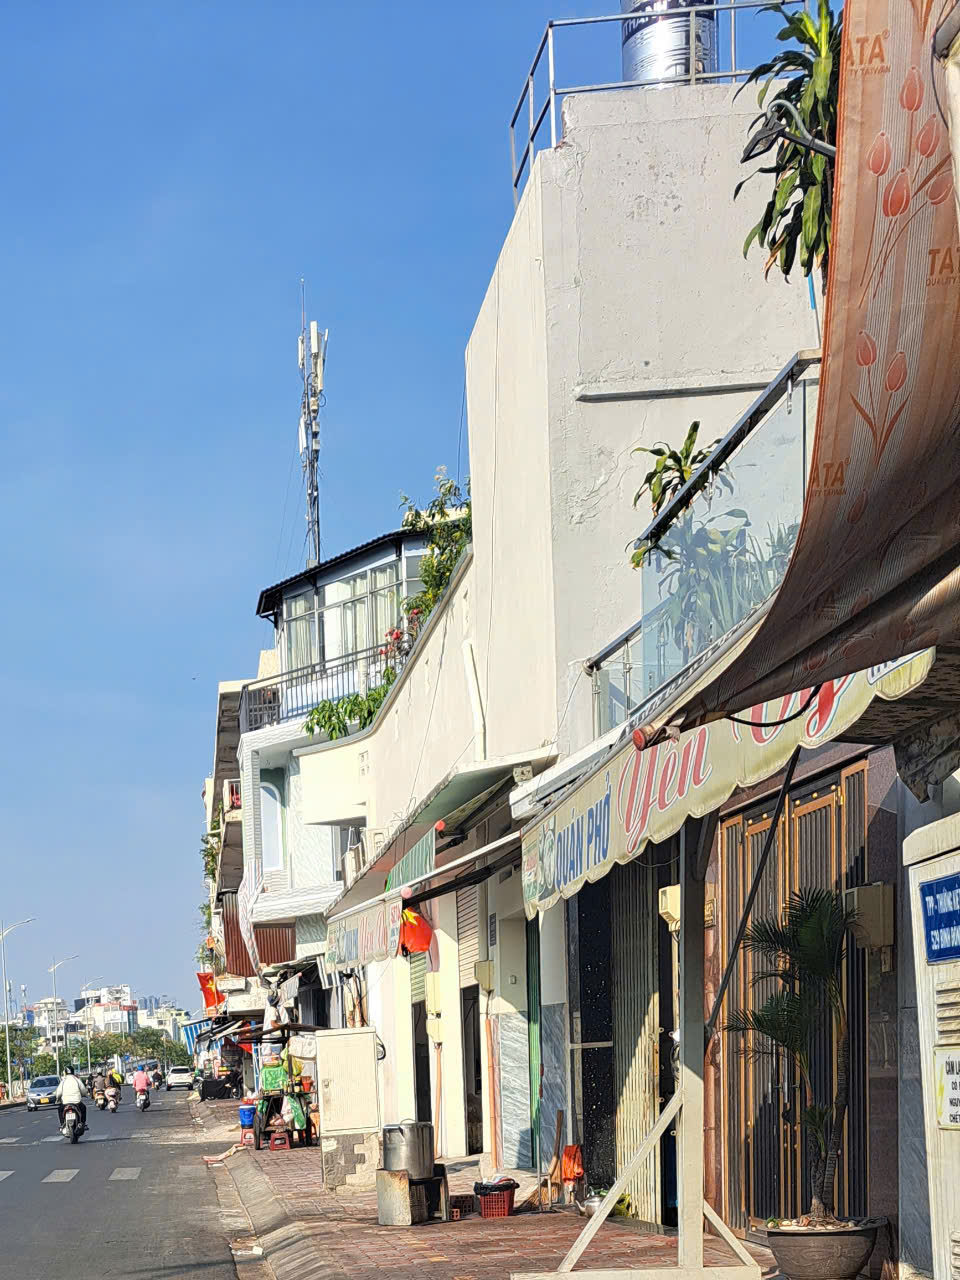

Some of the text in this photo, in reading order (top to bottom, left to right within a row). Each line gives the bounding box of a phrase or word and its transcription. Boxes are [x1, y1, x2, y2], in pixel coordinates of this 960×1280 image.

[928, 247, 960, 276] TA
[556, 808, 584, 890] QUÁN
[586, 770, 611, 871] PHỞ
